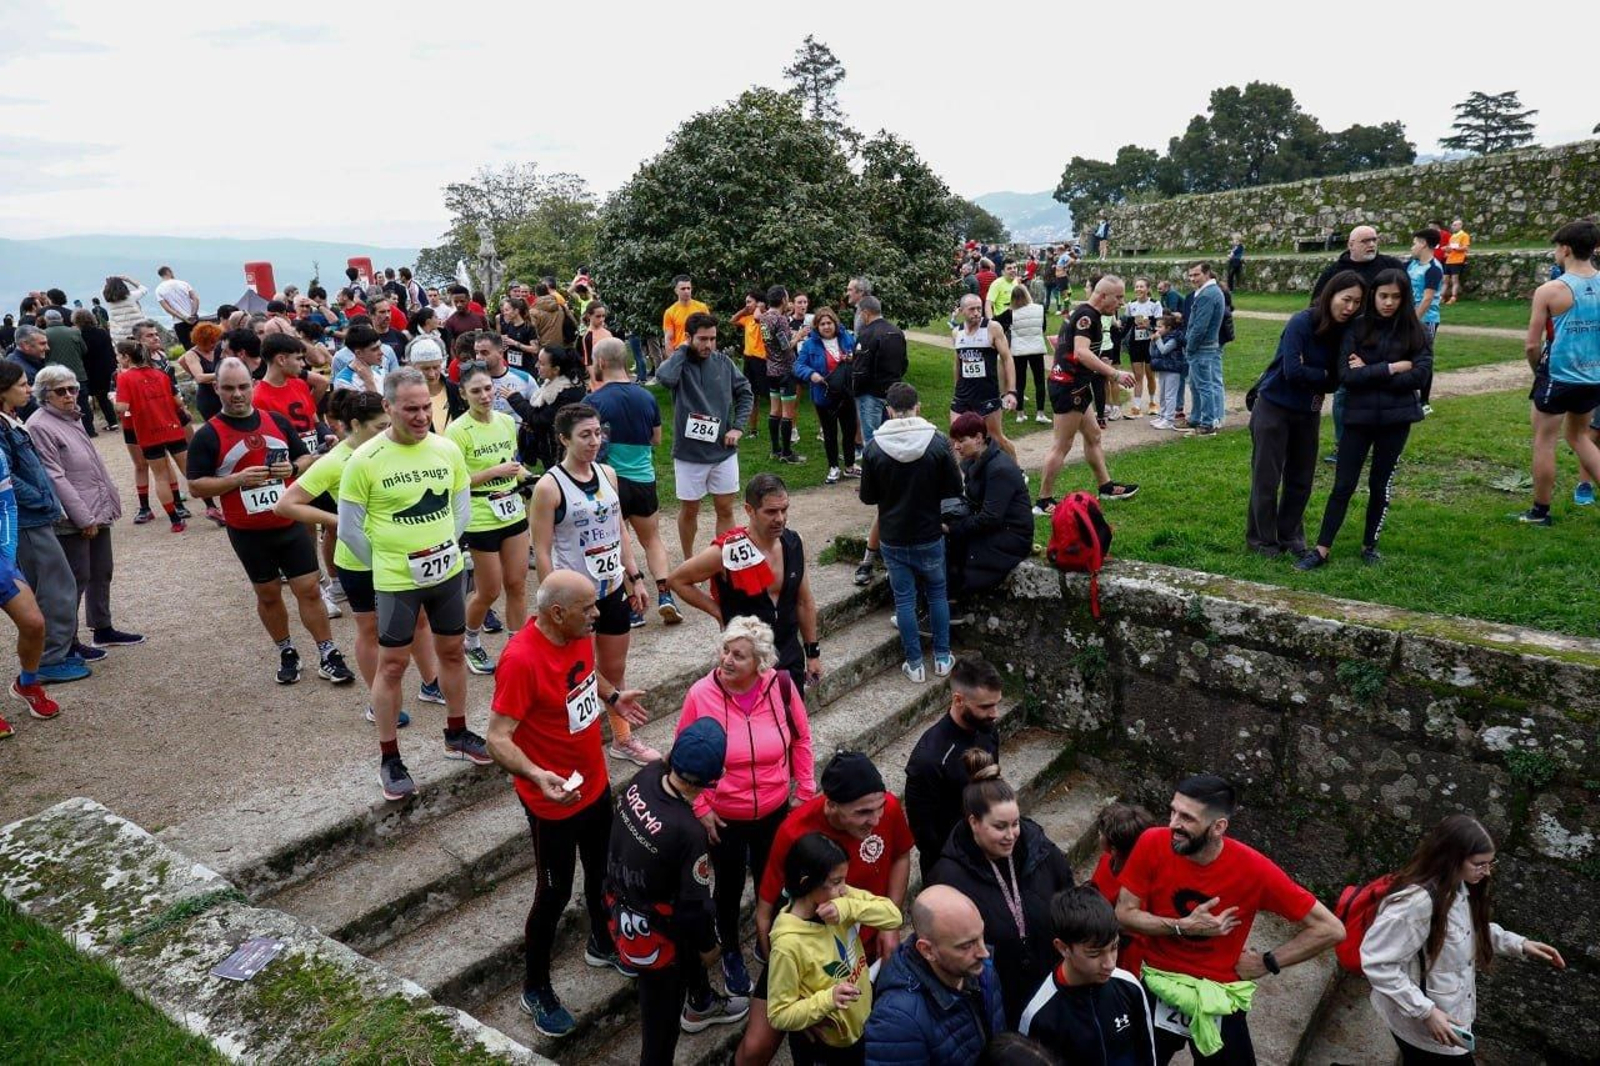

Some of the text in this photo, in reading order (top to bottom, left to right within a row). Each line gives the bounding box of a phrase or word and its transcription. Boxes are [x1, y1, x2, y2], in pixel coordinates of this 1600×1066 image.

[691, 421, 714, 437] 284
[382, 471, 412, 489] máis
[422, 467, 449, 481] auga
[250, 490, 279, 507] 140
[730, 543, 756, 563] 452
[421, 554, 451, 578] 279
[626, 784, 662, 835] CARMA
